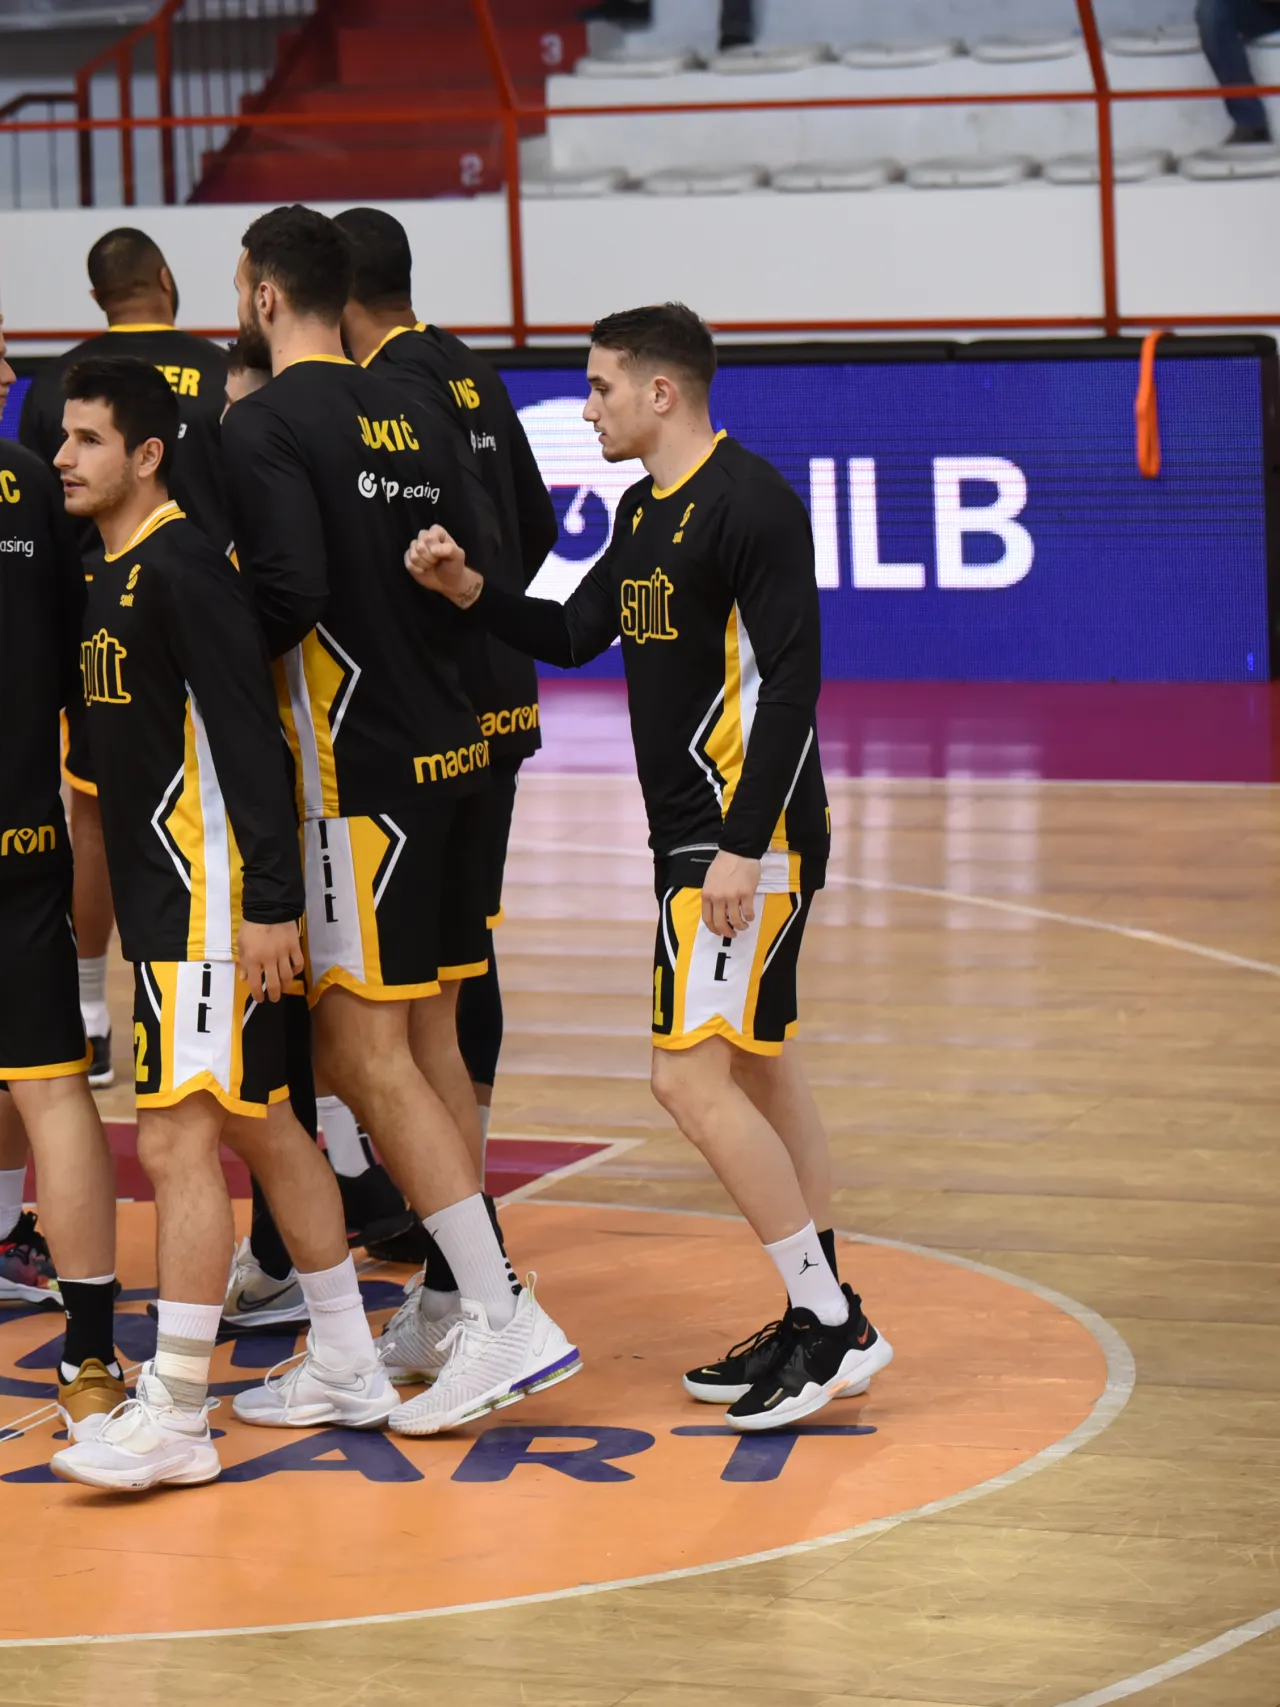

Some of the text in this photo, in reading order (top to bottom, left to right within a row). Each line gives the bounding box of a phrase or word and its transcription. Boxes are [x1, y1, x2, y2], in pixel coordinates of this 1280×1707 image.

[540, 33, 562, 66] 3
[460, 154, 482, 187] 2
[153, 365, 200, 397] ER
[621, 567, 679, 644] split
[80, 628, 132, 706] plit
[476, 703, 540, 737] acron
